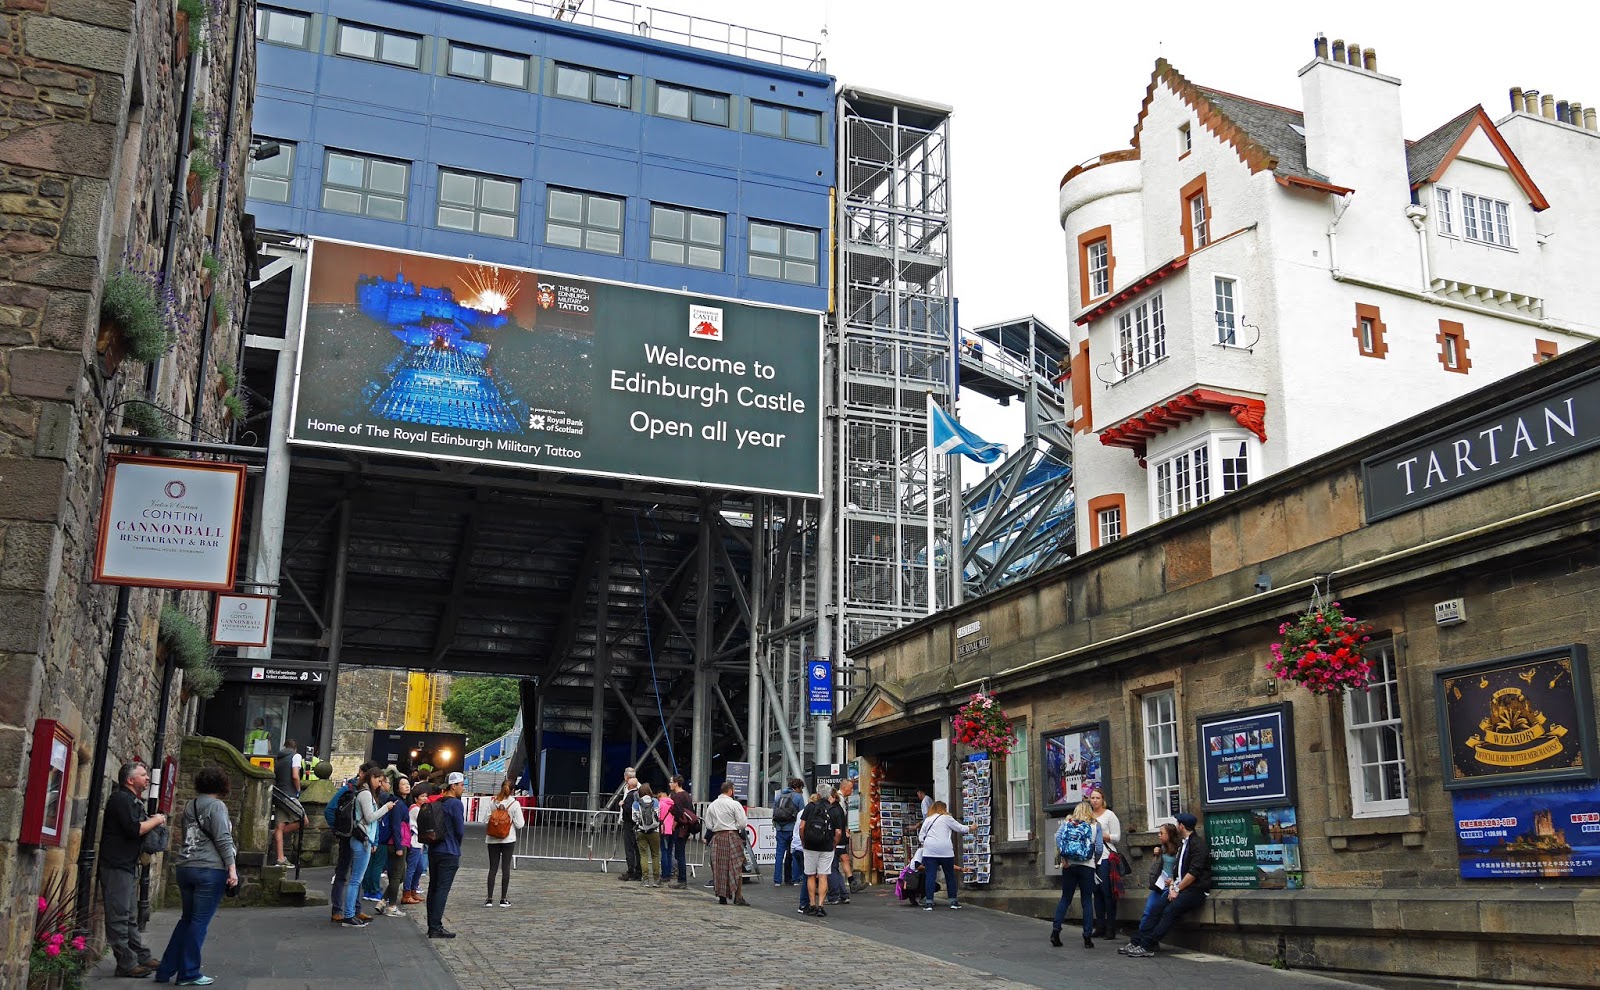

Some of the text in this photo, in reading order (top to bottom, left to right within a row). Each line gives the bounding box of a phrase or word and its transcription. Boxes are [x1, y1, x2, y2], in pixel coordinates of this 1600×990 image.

[558, 291, 589, 300] EDINBURGH
[570, 286, 588, 294] ROYAL
[558, 302, 589, 312] TATTOO
[693, 313, 719, 322] CASTLE
[644, 343, 775, 380] Welcome to
[610, 369, 805, 414] Edinburgh Castle
[546, 415, 583, 427] Royal Bank
[554, 425, 583, 435] Scotland
[630, 410, 786, 450] Open all year
[307, 418, 581, 459] Home of The Royal Edinburgh Military Tattoo
[1397, 397, 1576, 496] TARTAN
[142, 509, 203, 521] CONTINI
[116, 520, 224, 538] CANNONBALL
[120, 534, 186, 545] RESTAURANT
[1493, 730, 1535, 744] WIZARDRY
[1496, 754, 1510, 762] HARRY
[1511, 753, 1527, 762] POTTER
[1231, 836, 1235, 844] 4
[1236, 836, 1248, 846] Day
[1236, 848, 1253, 857] Tours
